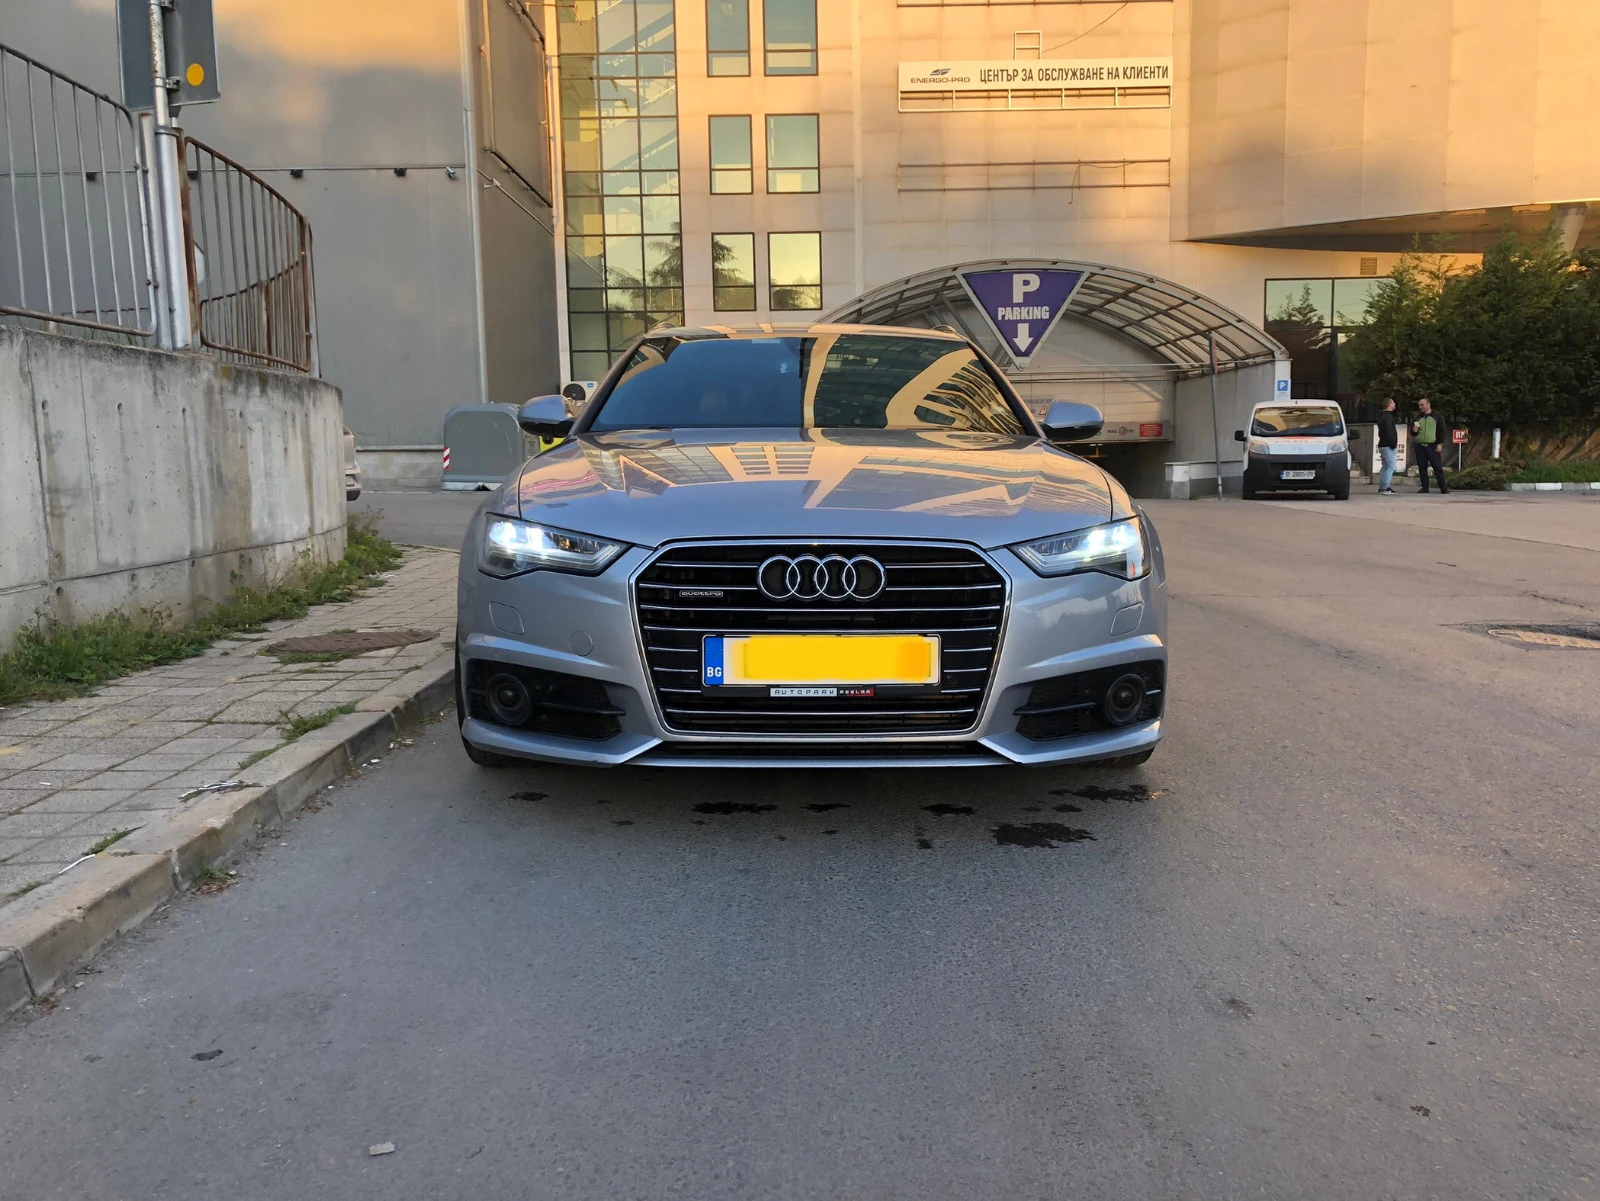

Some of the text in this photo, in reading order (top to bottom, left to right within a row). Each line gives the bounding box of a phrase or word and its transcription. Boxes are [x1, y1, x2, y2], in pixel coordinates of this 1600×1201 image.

[910, 76, 970, 84] ENERGO-PRO
[980, 65, 1168, 84] ЦЕНТЪР ЗА ОБСЛУЖВАНЕ НА КЛИЕНТИ
[1012, 273, 1040, 303] P
[997, 306, 1050, 320] PARKING
[706, 667, 722, 678] BG
